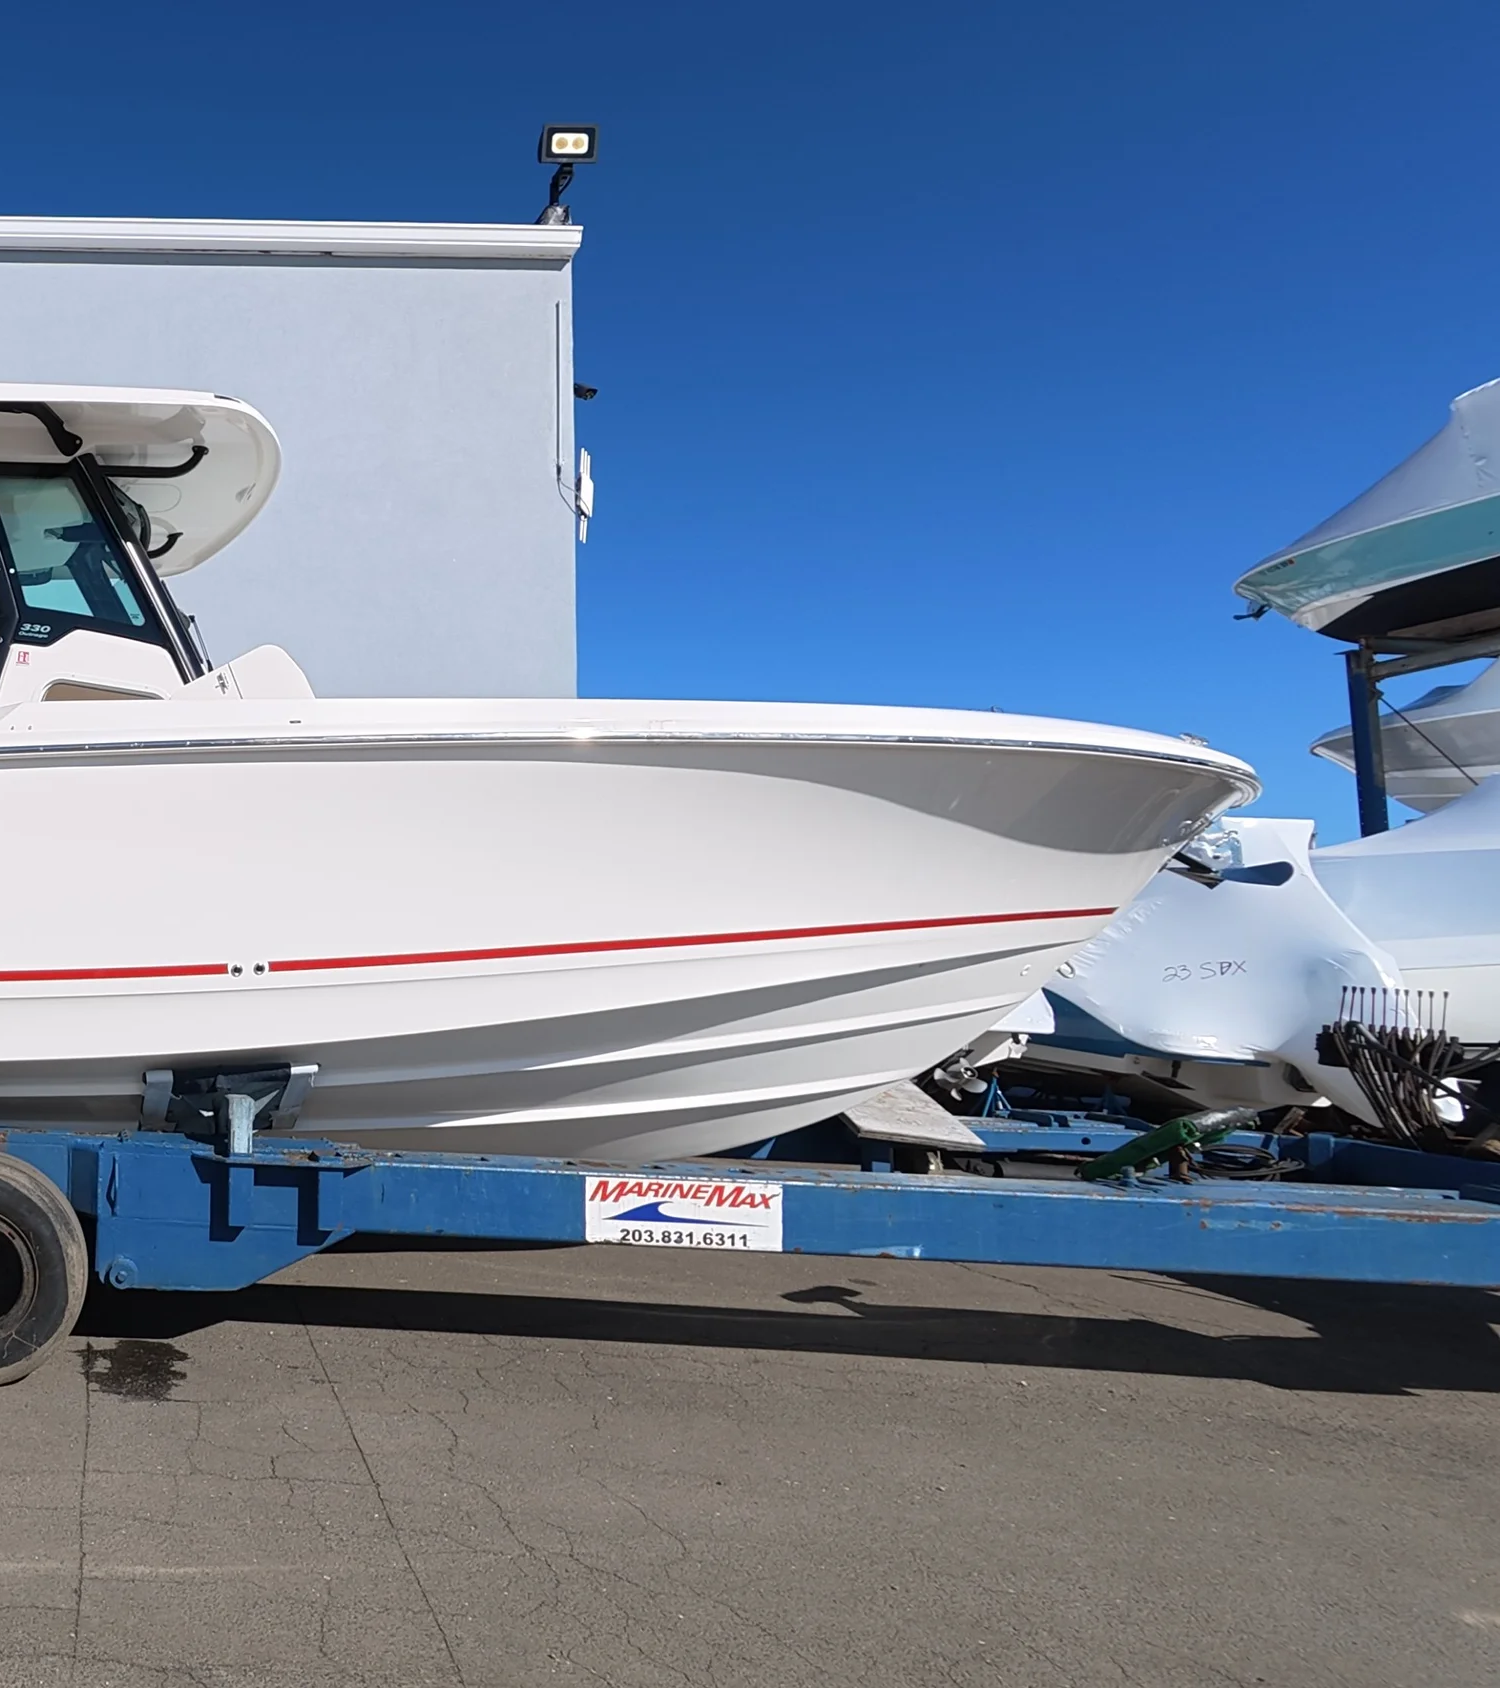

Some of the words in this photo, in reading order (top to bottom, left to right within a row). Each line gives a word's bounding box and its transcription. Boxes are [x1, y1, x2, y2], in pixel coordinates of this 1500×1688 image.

[20, 623, 51, 633] 330
[1162, 964, 1192, 982] 23
[620, 1229, 749, 1247] 203.831.6311
